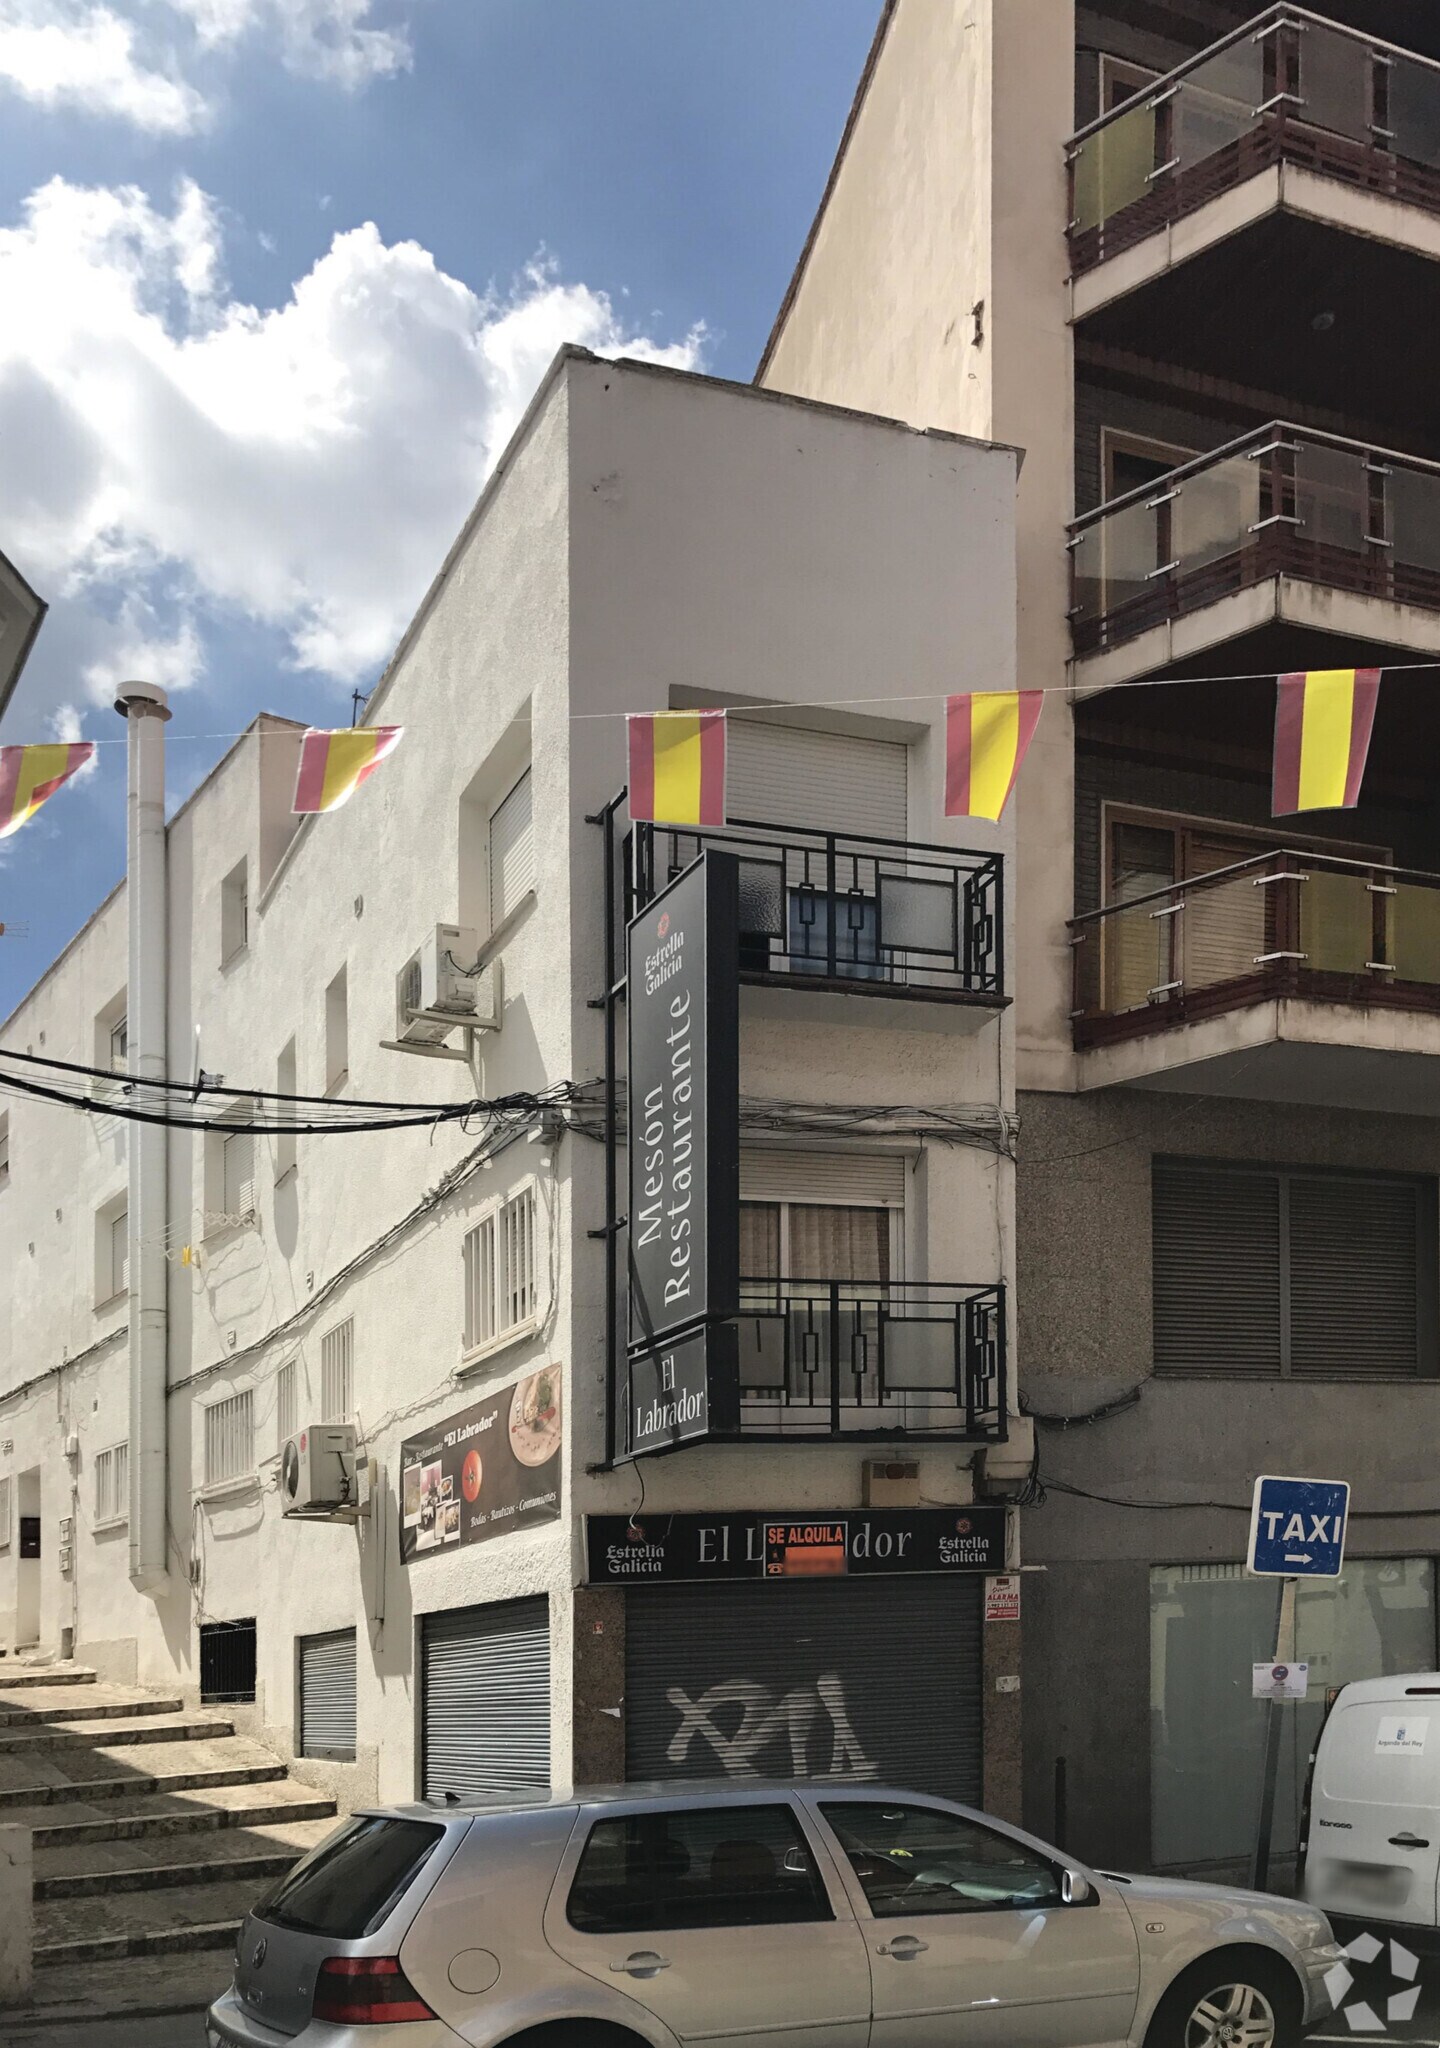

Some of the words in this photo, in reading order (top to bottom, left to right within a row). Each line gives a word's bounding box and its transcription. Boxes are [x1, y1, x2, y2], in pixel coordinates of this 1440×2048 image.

[644, 931, 684, 977] Estrella
[645, 954, 682, 996] Galicia
[664, 988, 692, 1308] Restaurante
[637, 1083, 664, 1250] Mesón
[662, 1354, 676, 1392] El
[636, 1387, 705, 1438] Labrador
[697, 1525, 730, 1563] El
[768, 1528, 785, 1545] SE
[788, 1526, 844, 1544] ALQUILA
[938, 1536, 990, 1550] Estrella
[1262, 1511, 1342, 1544] TAXI
[606, 1544, 665, 1559] Estrella
[608, 1558, 662, 1573] Galicia
[939, 1549, 987, 1564] Galicia
[987, 1593, 1019, 1601] ALARMA
